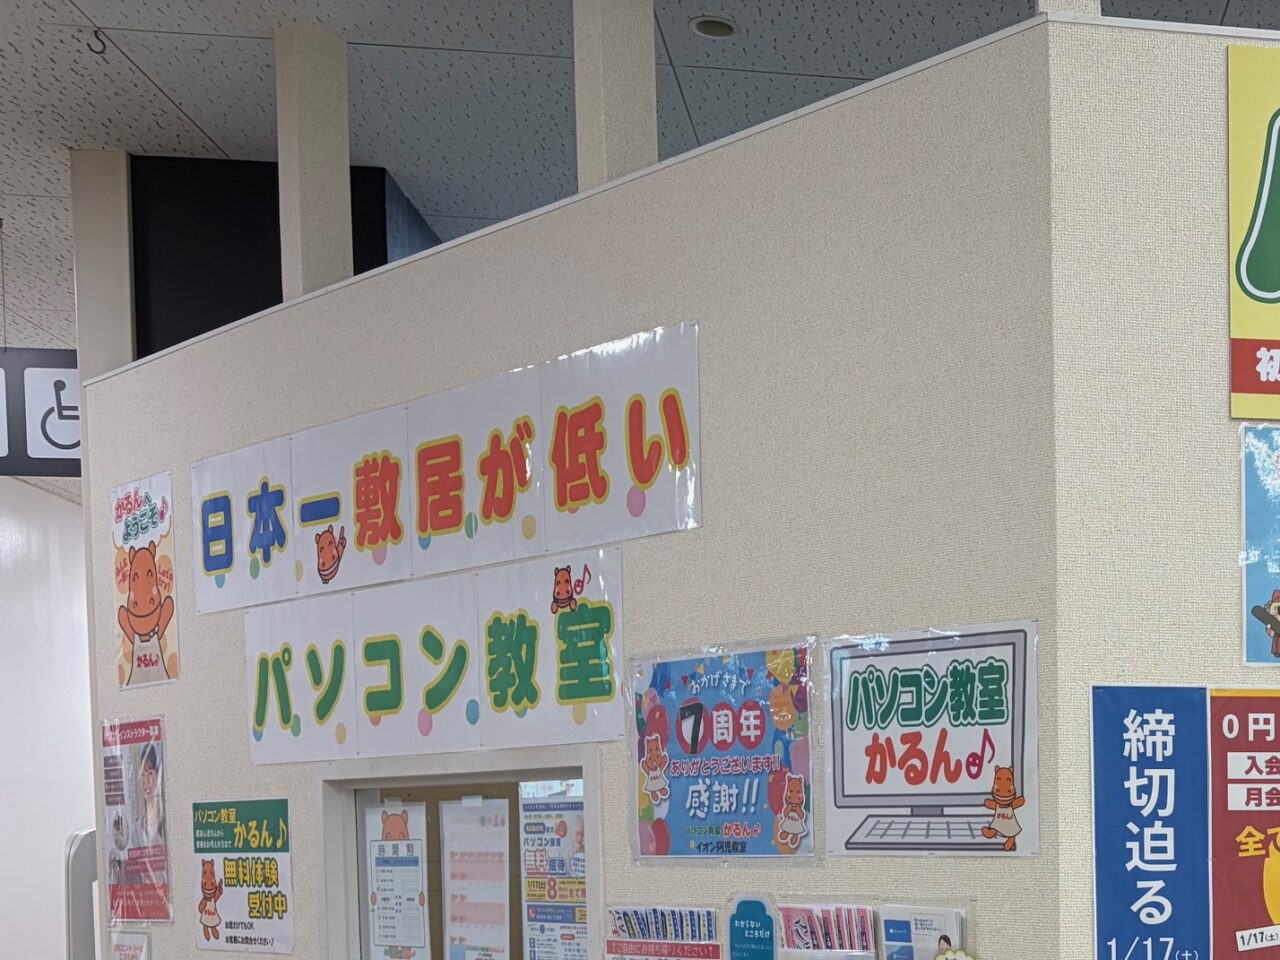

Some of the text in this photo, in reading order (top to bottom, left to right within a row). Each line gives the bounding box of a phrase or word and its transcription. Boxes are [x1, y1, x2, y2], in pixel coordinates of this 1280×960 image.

[202, 388, 690, 575] 日本一敷居が低い
[252, 600, 615, 730] パソコン教室
[690, 671, 750, 694] おかげさまで
[846, 656, 1009, 731] パソコン教室
[686, 778, 759, 818] 感謝!!
[195, 809, 237, 824] パソコン教室
[1122, 707, 1177, 926] 締切迫る
[223, 857, 279, 887] 無料体験
[248, 891, 287, 919] 受付中
[1239, 932, 1279, 946] 1/17(土)
